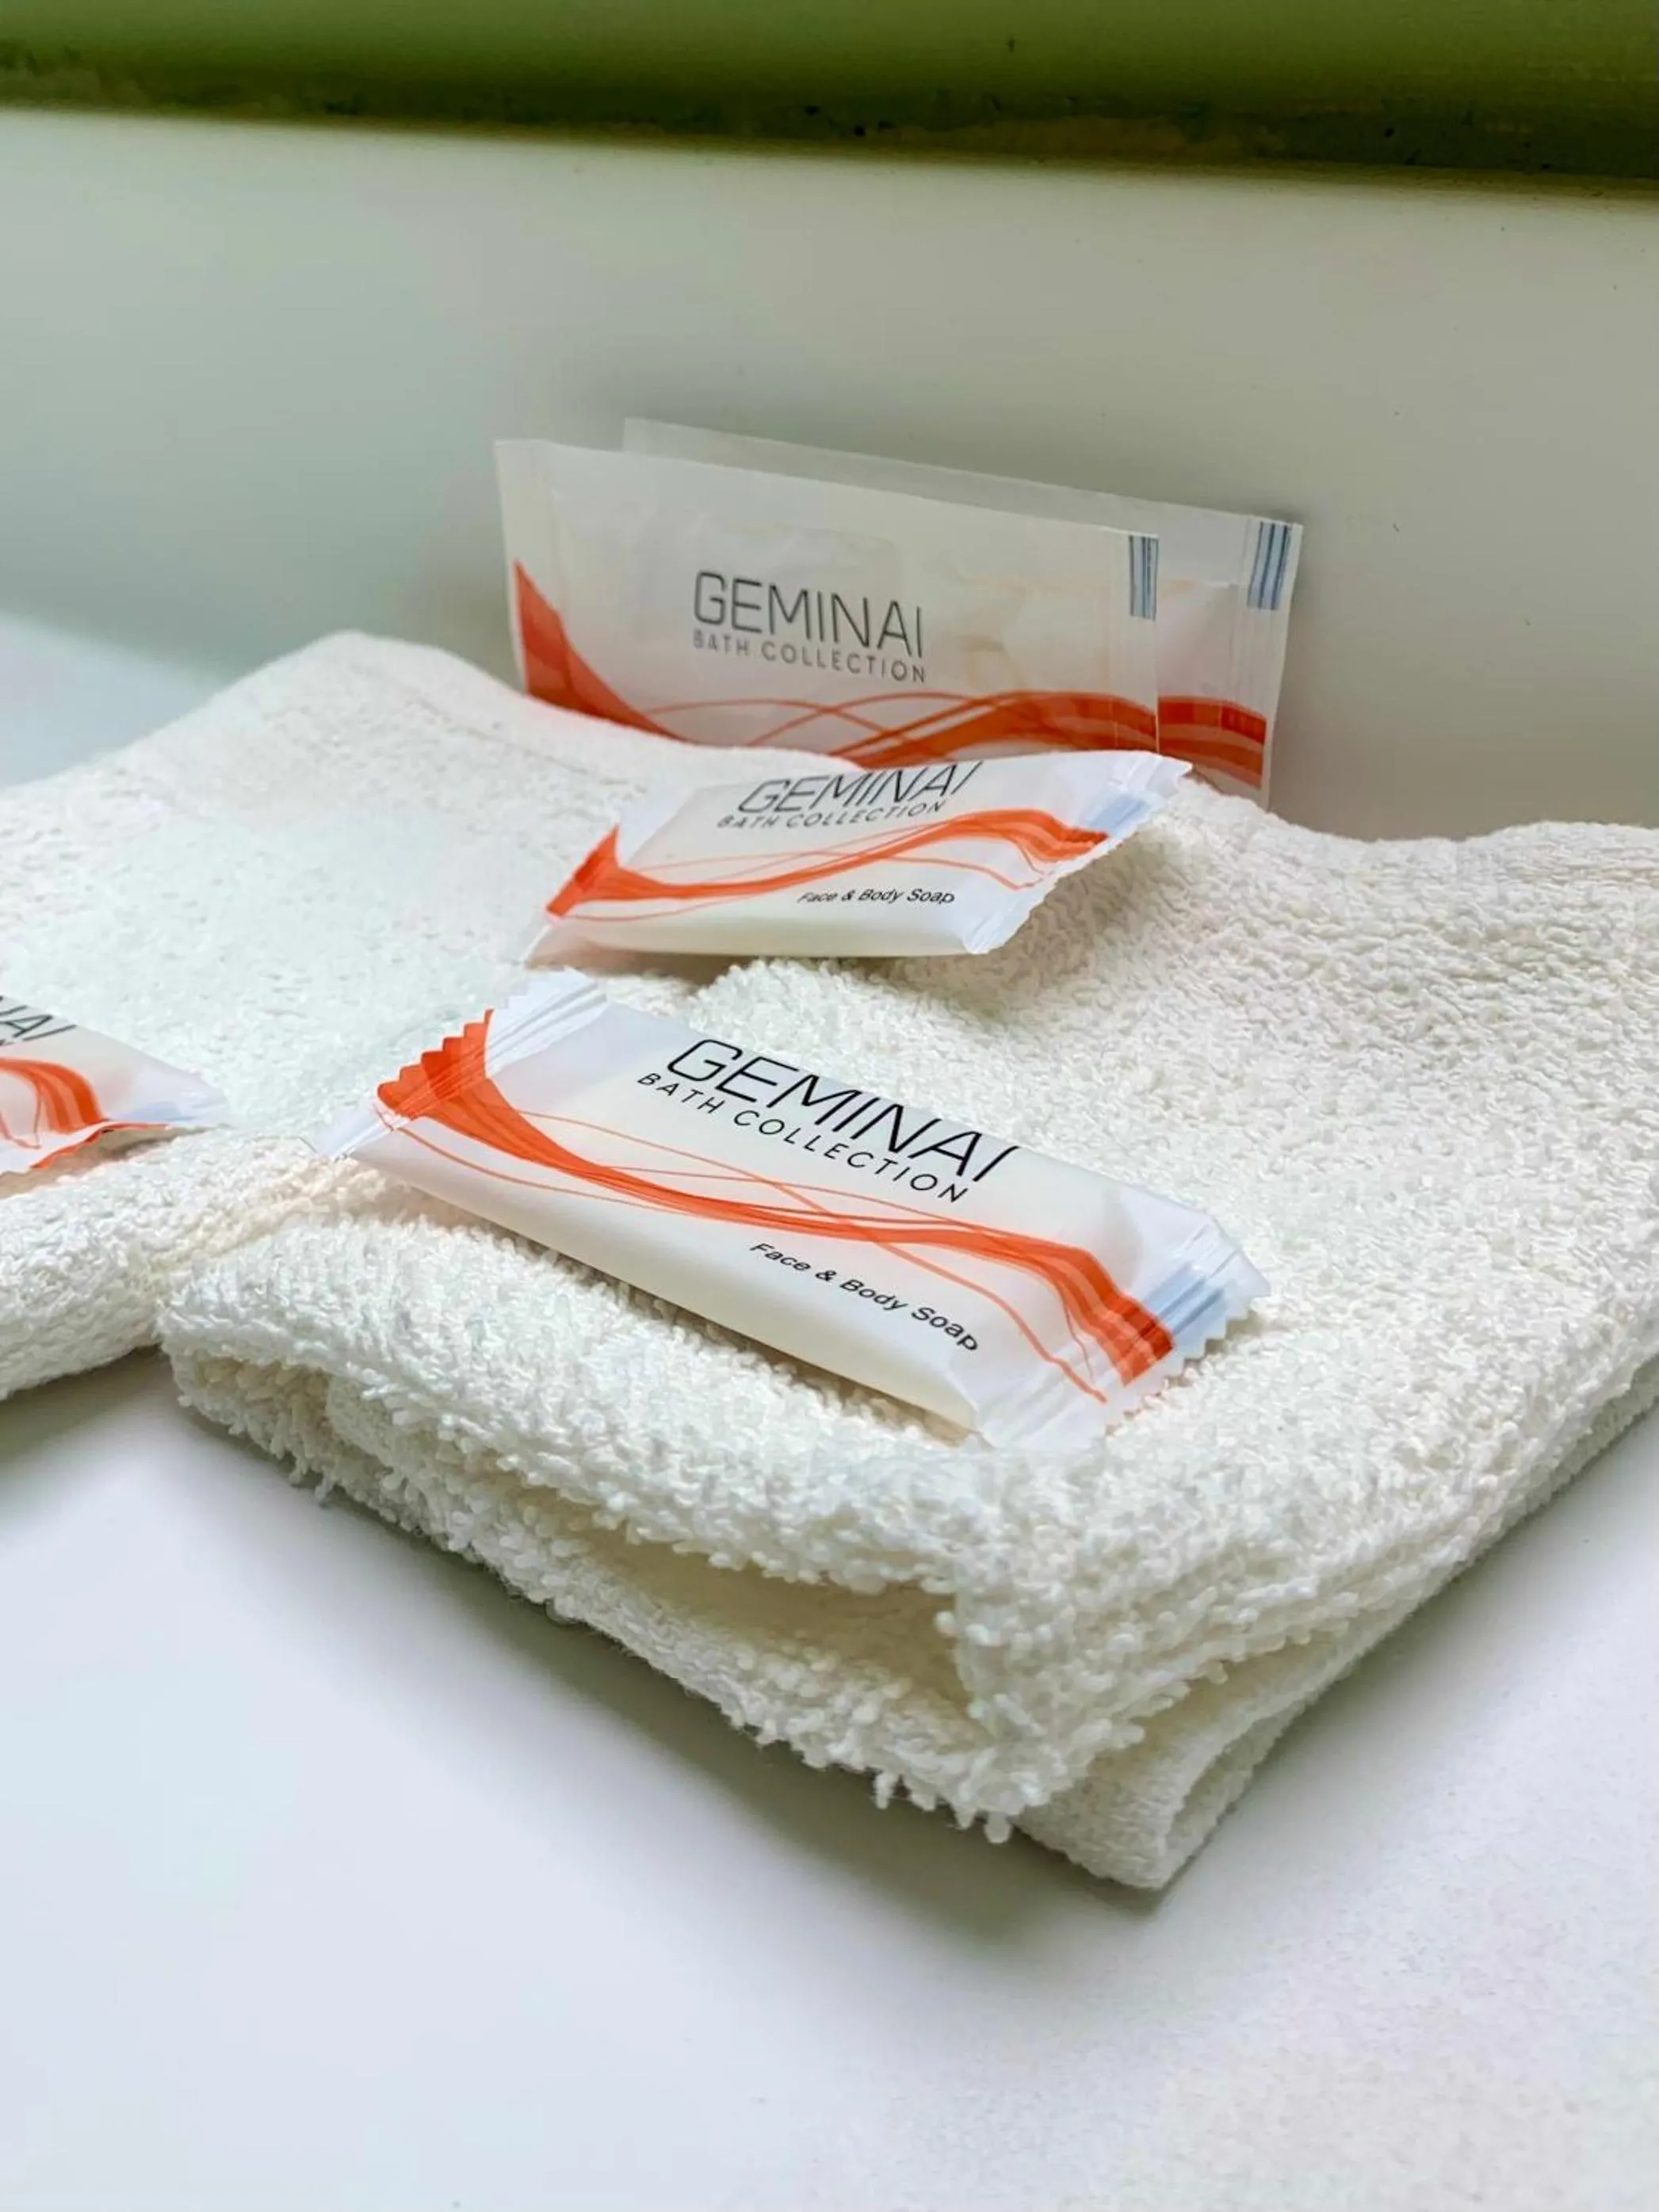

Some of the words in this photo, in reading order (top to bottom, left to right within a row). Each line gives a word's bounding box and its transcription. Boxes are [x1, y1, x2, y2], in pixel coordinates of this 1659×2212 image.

[694, 570, 923, 659] GEMINAI
[693, 629, 750, 655] BATH
[761, 640, 927, 683] COLLECTION
[717, 814, 775, 829] BATH
[786, 800, 946, 828] COLLECTION
[738, 760, 984, 813] GEMINAI
[797, 889, 835, 904] Face
[842, 889, 857, 902] &
[858, 888, 904, 905] Body
[907, 888, 956, 907] Soap
[637, 1072, 724, 1115] BATH
[733, 1110, 968, 1203] COLLECTION
[667, 1039, 1020, 1182] GEMINAI
[749, 1242, 811, 1272] Face
[816, 1269, 837, 1283] &
[839, 1278, 909, 1312] Body
[912, 1305, 978, 1353] Soap
